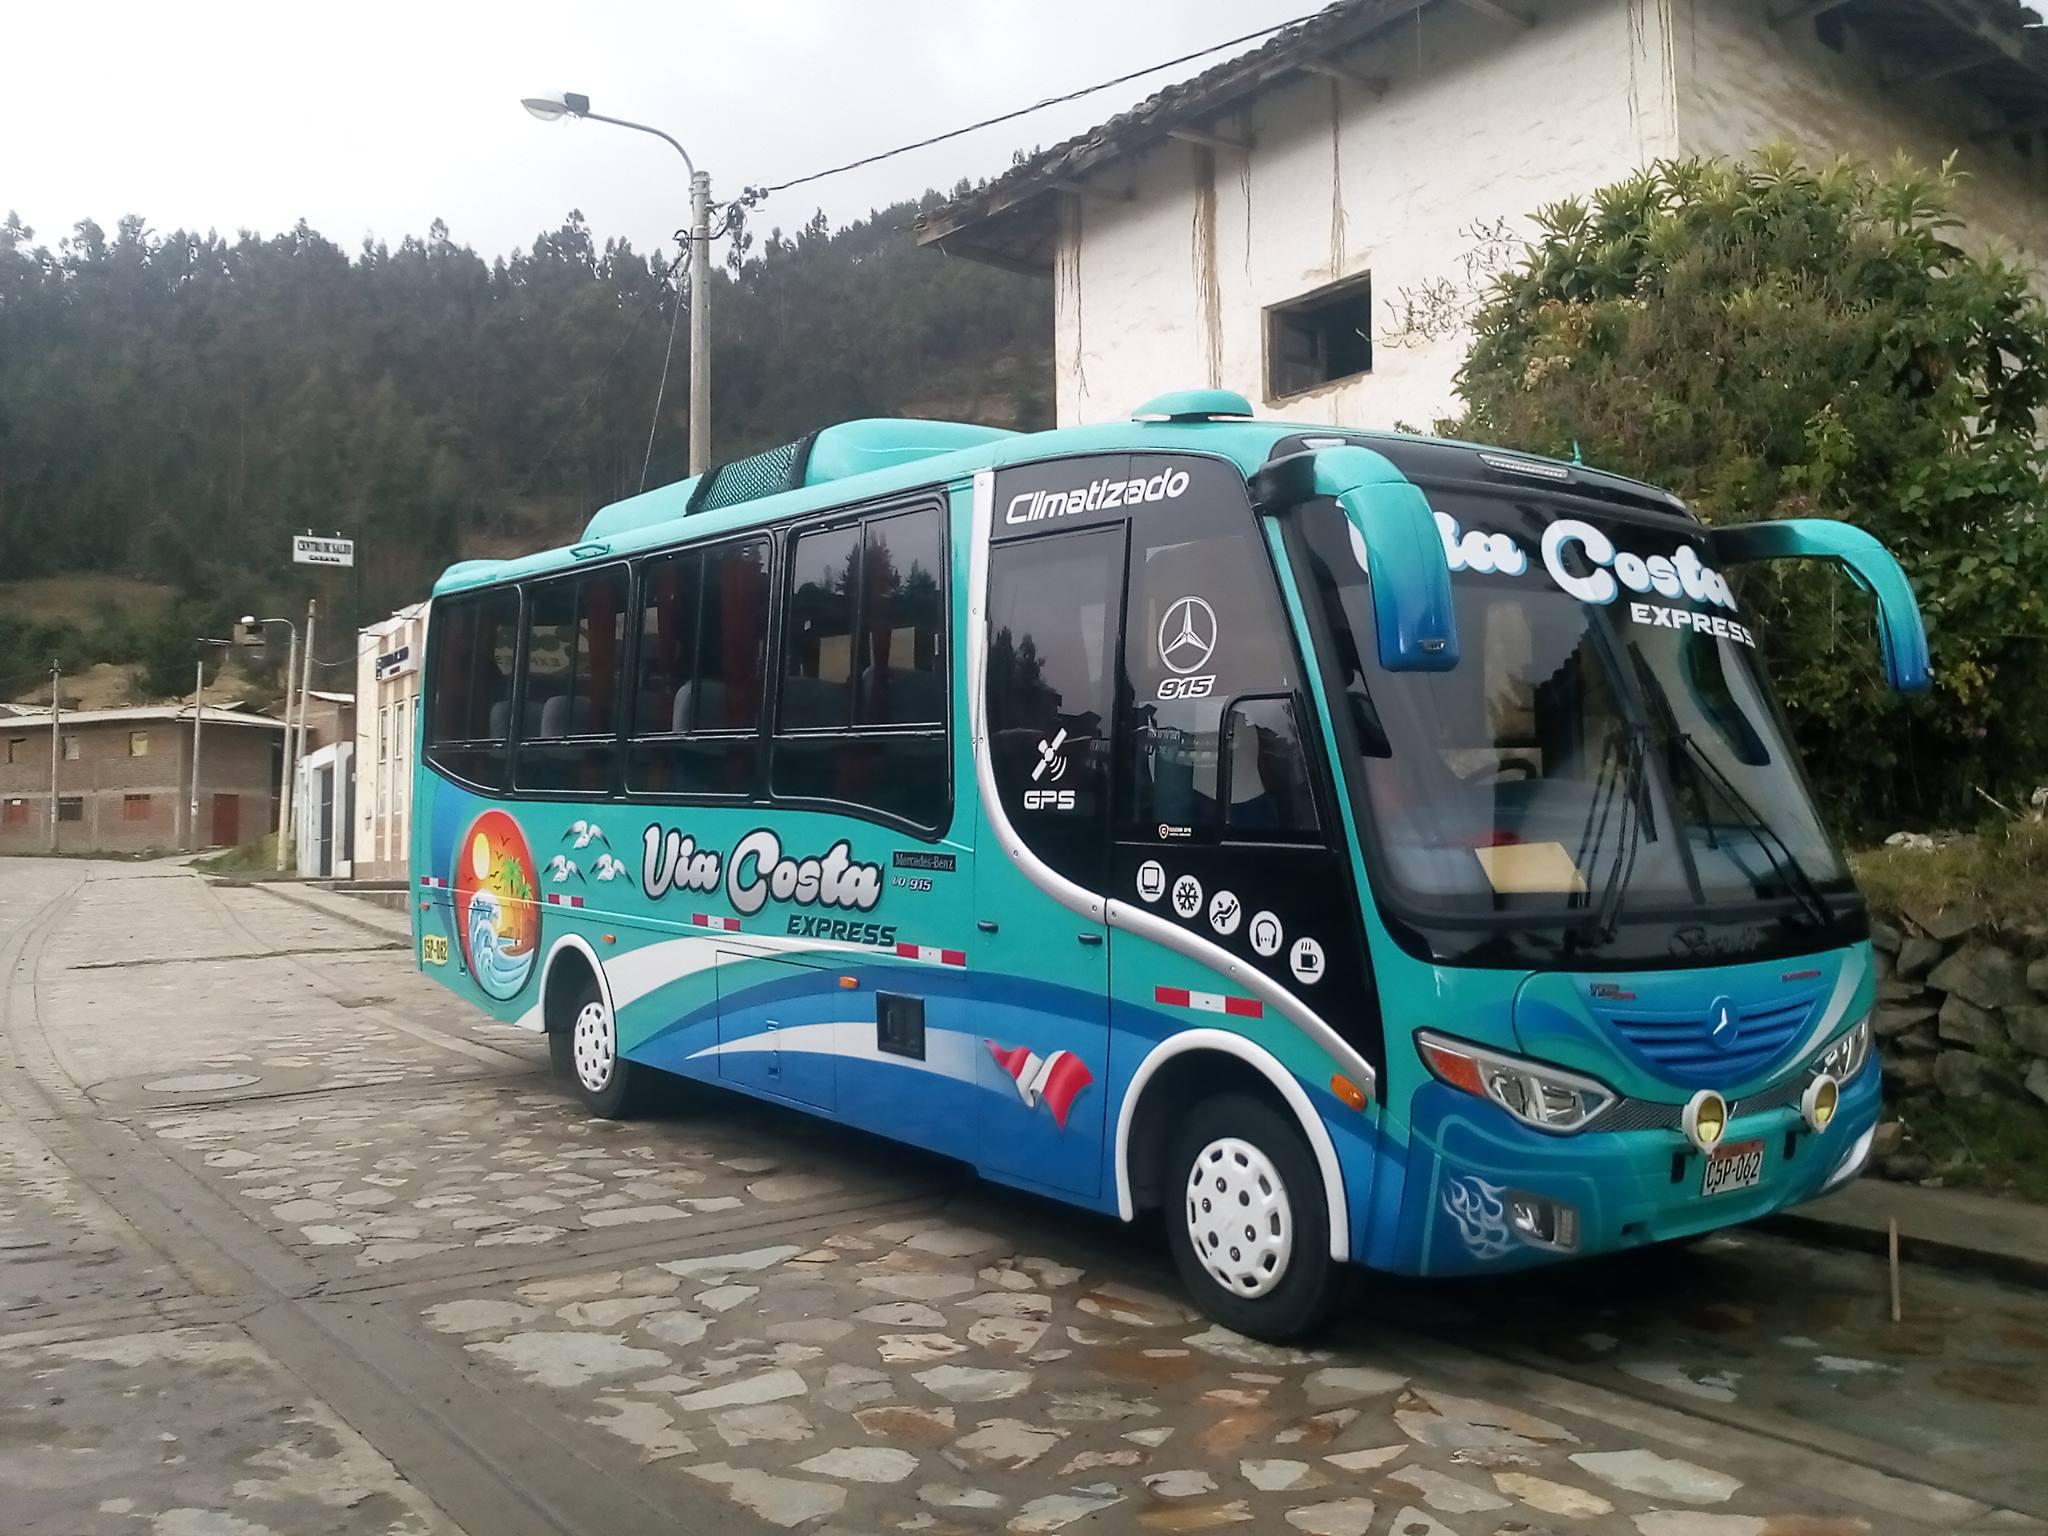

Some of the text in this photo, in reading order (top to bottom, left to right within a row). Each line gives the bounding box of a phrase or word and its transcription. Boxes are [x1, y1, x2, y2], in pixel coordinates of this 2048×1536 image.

[1006, 467, 1190, 525] Climatizado
[1541, 519, 1737, 613] Costa
[1630, 602, 1755, 648] EXPRESS
[1157, 674, 1216, 699] 915
[1024, 790, 1075, 809] GPS
[642, 822, 886, 917] Via Costa
[894, 853, 955, 870] Mercedes-Benz
[909, 878, 932, 891] 915
[787, 914, 897, 948] EXPRESS
[1707, 1152, 1760, 1189] C5P-062
